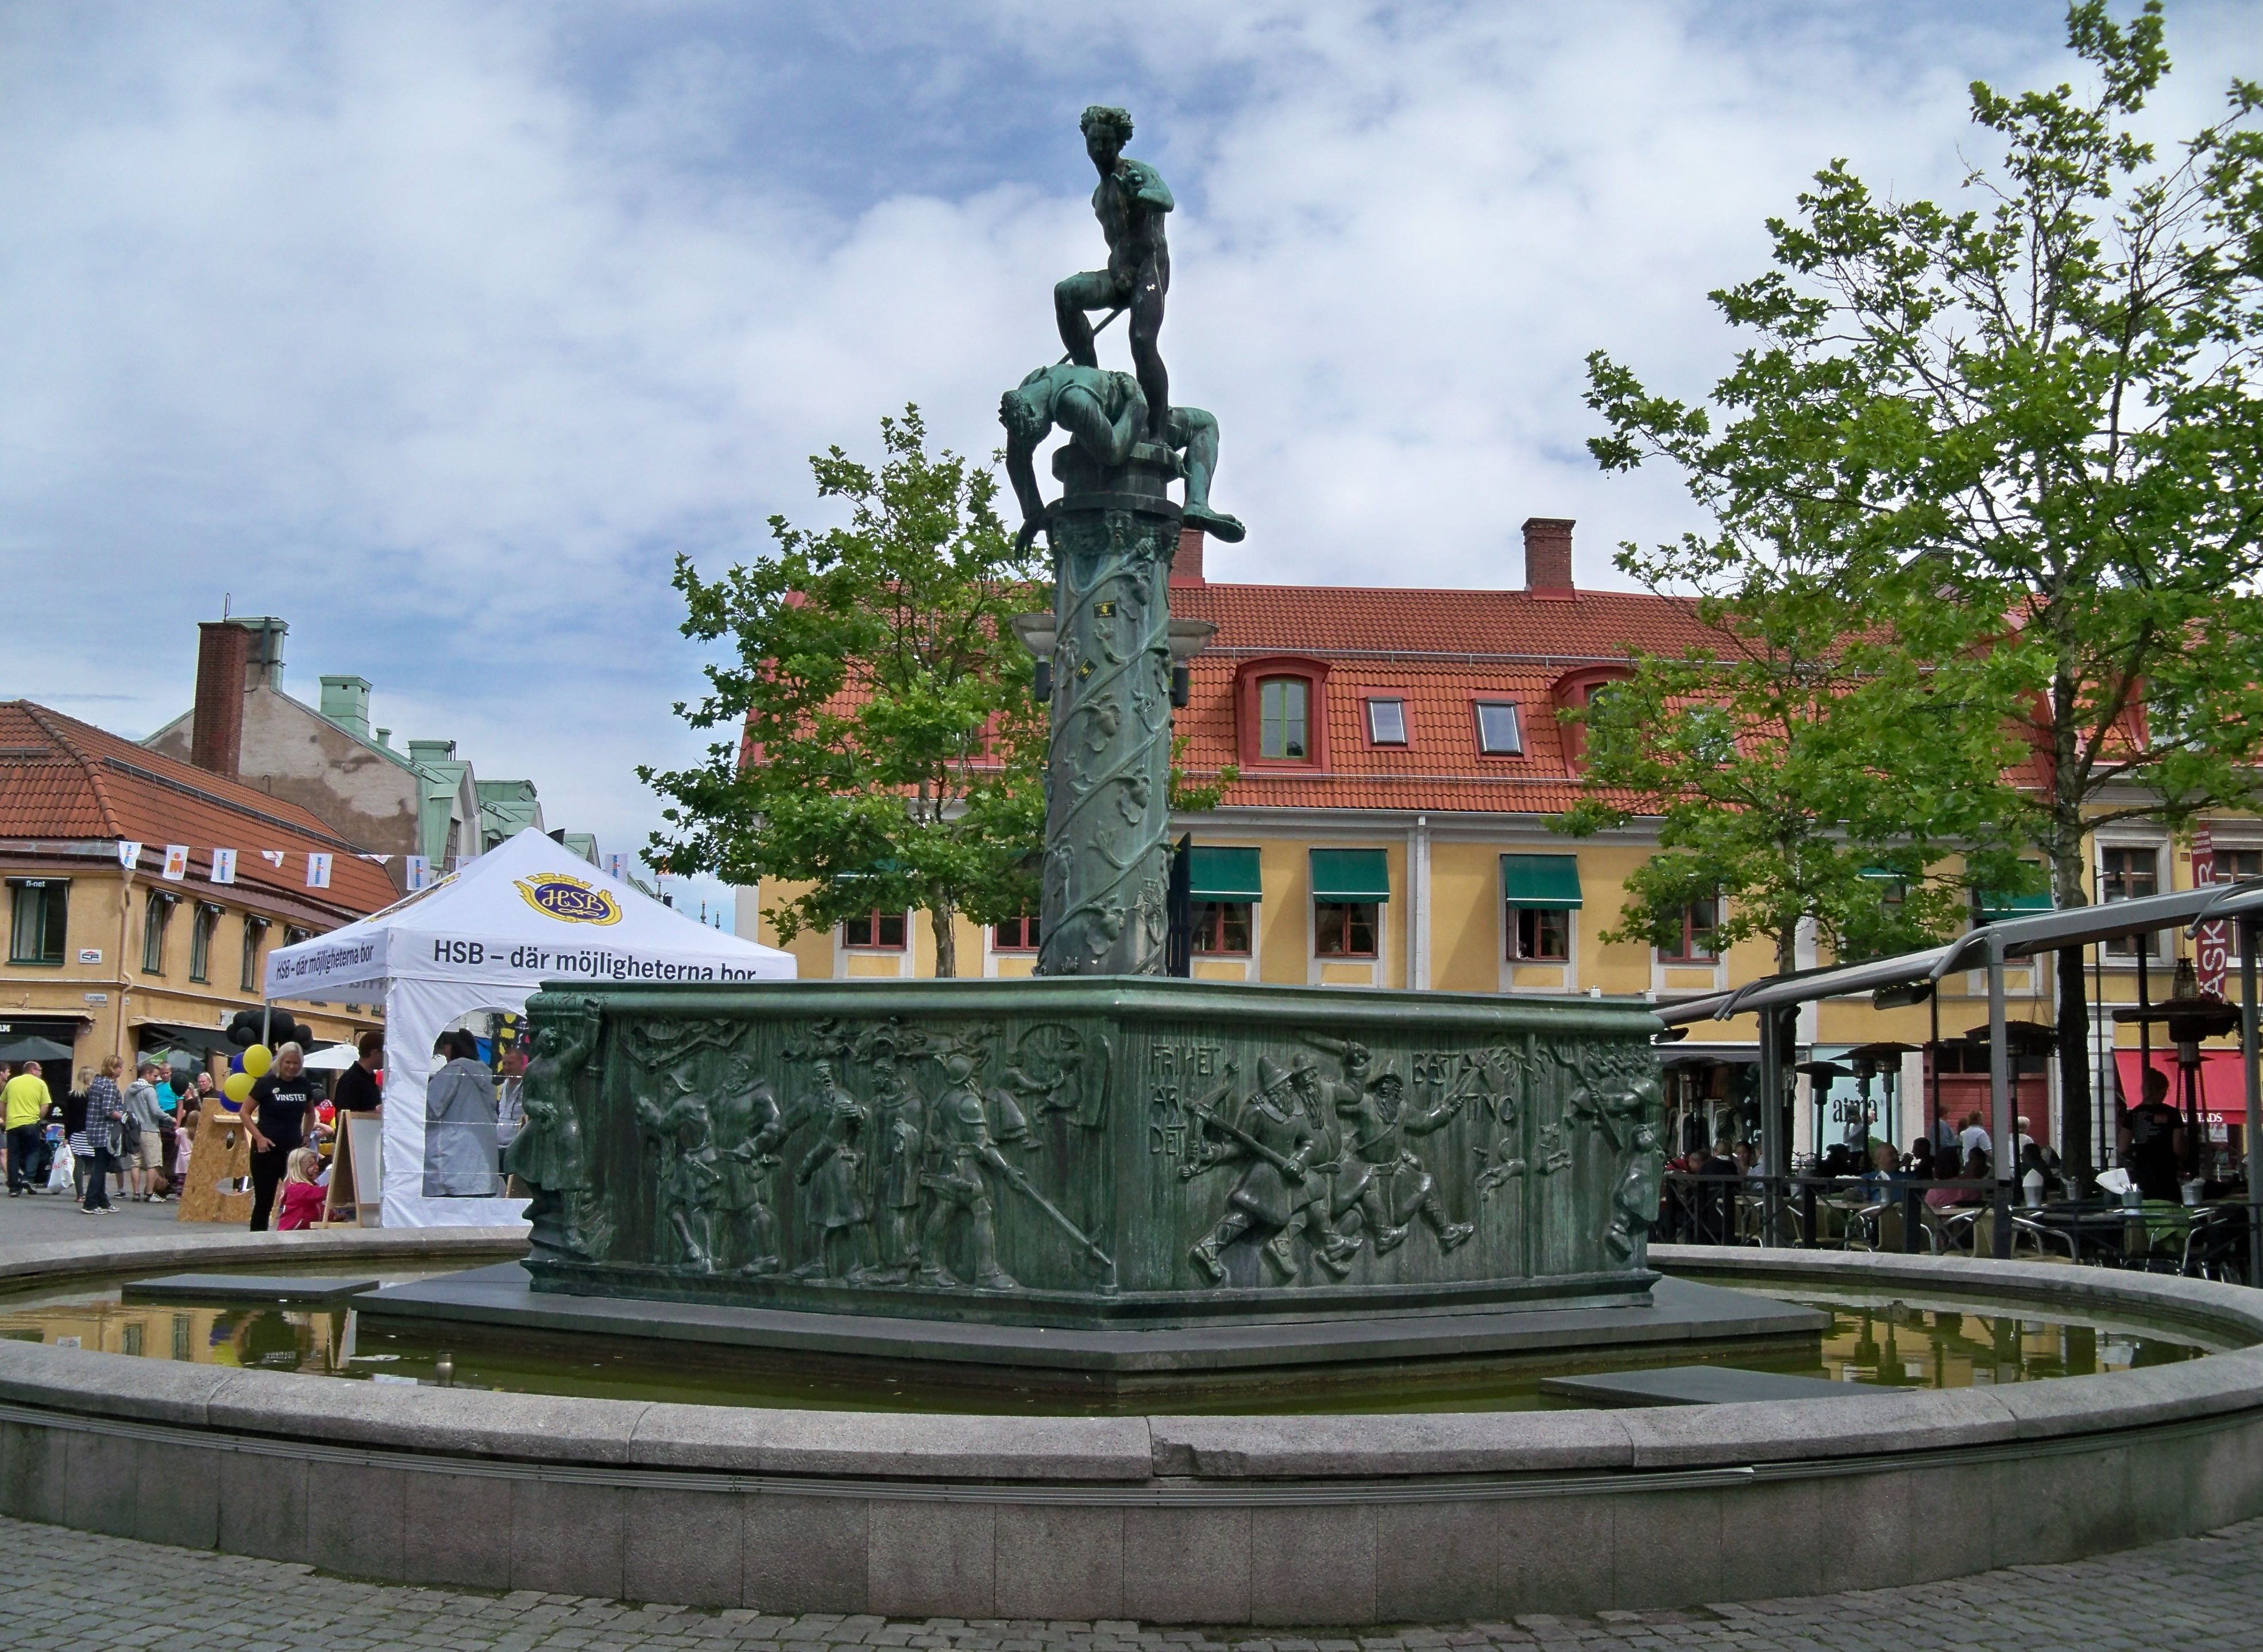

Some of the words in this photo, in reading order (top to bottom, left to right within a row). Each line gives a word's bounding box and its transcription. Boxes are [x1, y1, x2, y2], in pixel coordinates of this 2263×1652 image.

[541, 889, 605, 911] HSB
[276, 959, 290, 981] HSB
[296, 955, 308, 976] där
[308, 947, 358, 976] möjligheterna
[361, 942, 374, 962] bor
[434, 939, 484, 965] HSB
[511, 946, 550, 969] där
[556, 950, 713, 980] möjligheterna
[721, 962, 756, 980] bor
